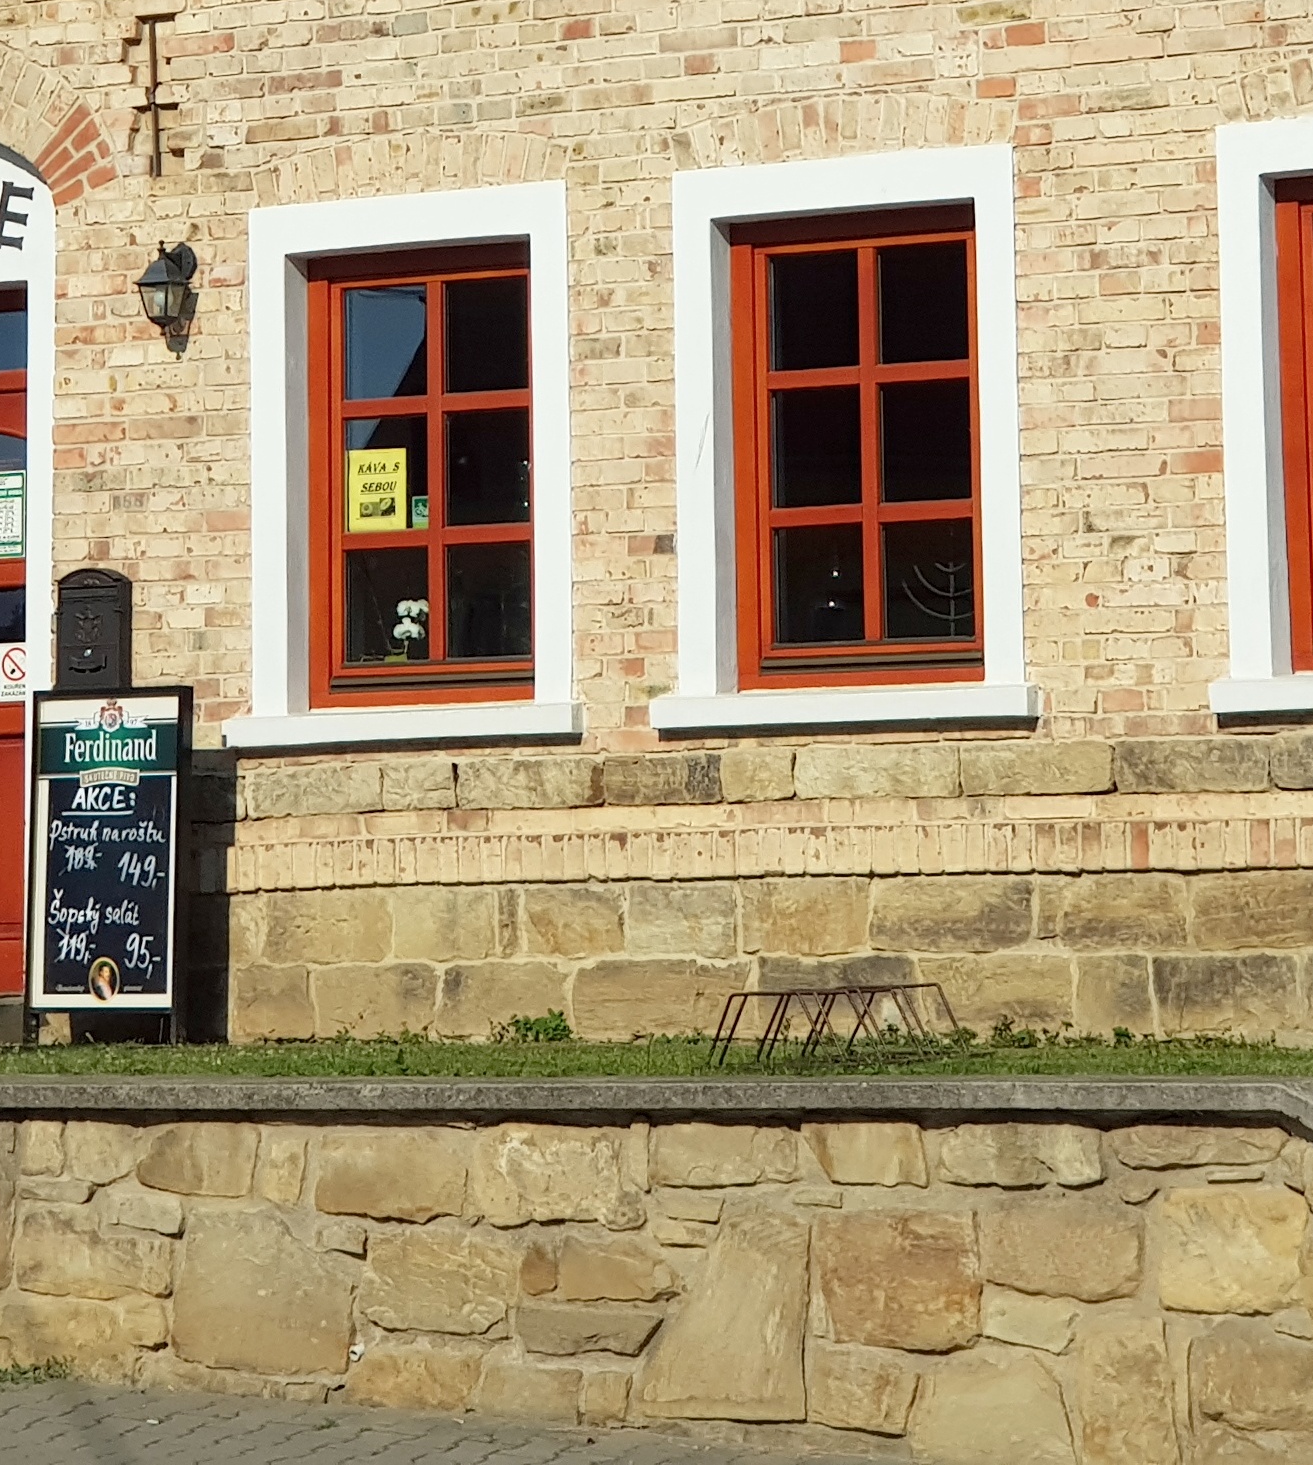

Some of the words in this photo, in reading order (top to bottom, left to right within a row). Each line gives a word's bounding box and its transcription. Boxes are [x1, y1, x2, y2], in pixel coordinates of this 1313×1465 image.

[358, 461, 386, 474] KÁVA
[393, 462, 400, 472] S
[361, 481, 397, 493] SEBOU
[64, 728, 157, 763] Ferdinand
[71, 786, 136, 811] AKCE:
[49, 819, 100, 851] Pstruh
[104, 899, 140, 925] salát
[123, 932, 161, 979] 95,-
